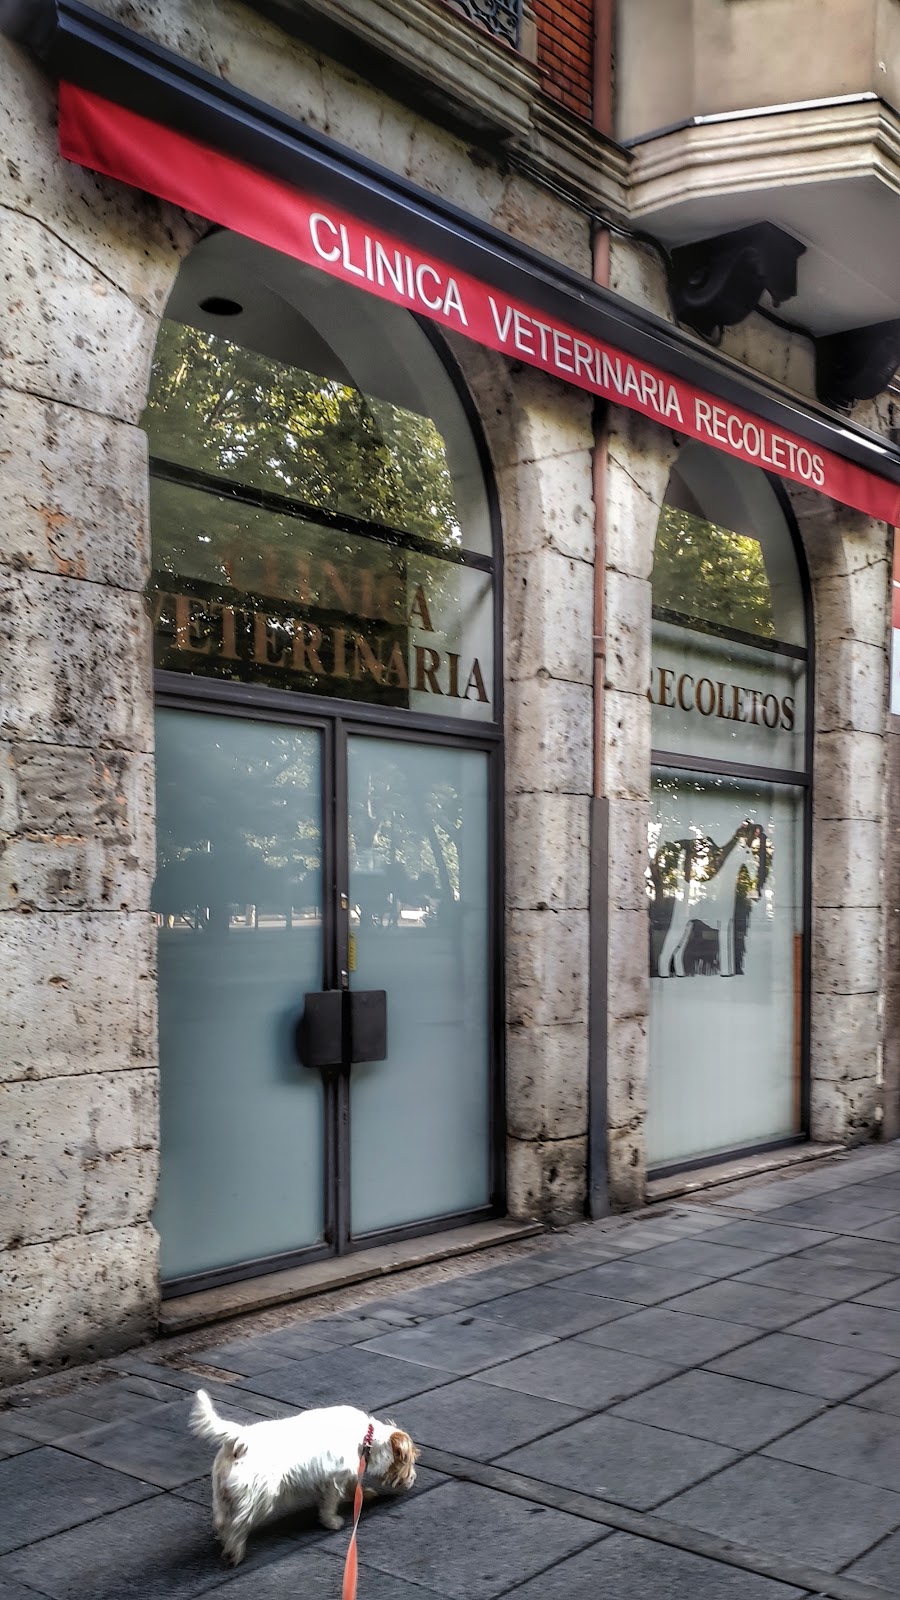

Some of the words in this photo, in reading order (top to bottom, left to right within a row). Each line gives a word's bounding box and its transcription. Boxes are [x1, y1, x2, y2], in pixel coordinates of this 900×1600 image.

[308, 212, 468, 327] CLINICA
[488, 295, 684, 424] VETERINARIA
[694, 397, 826, 487] RECOLETOS
